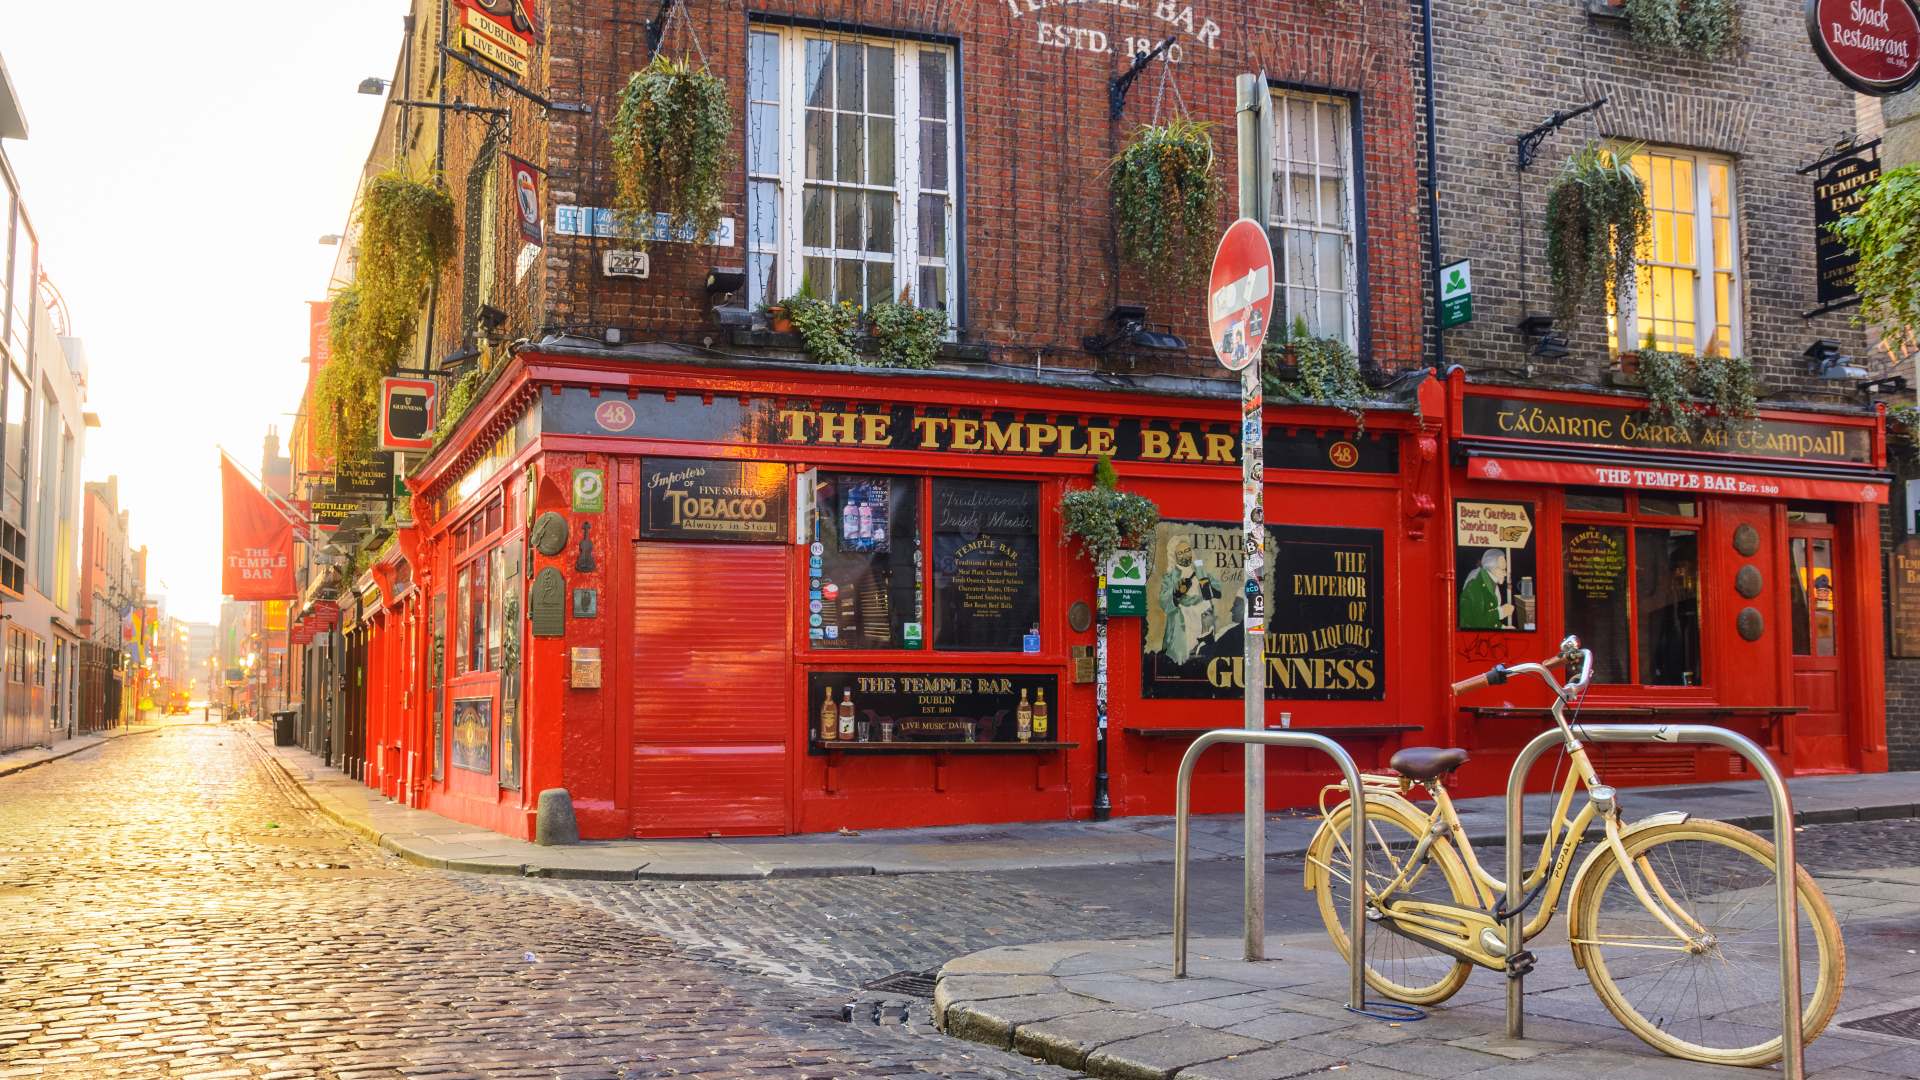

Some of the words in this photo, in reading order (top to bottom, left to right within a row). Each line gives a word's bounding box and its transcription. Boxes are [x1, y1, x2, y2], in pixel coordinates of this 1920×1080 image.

[1154, 0, 1221, 50] BAR
[1849, 0, 1890, 32] Shack
[480, 17, 516, 48] DUBLIN
[1832, 22, 1910, 59] Restaurant
[472, 35, 493, 56] LIVE
[495, 49, 524, 72] MUSIC
[1836, 164, 1858, 178] THE
[1817, 168, 1880, 201] TEMPLE
[602, 405, 626, 424] 48
[779, 409, 893, 447] THE
[914, 416, 1118, 456] TEMPLE
[1140, 429, 1236, 463] BAR
[1333, 445, 1352, 463] 48
[647, 466, 707, 489] Importers
[1596, 468, 1632, 484] THE
[1634, 471, 1700, 489] TEMPLE
[1703, 475, 1737, 491] BAR
[1761, 485, 1779, 495] 1840
[699, 486, 721, 495] FINE
[722, 486, 767, 497] SMOKING
[312, 502, 360, 511] DISTILLERY
[320, 511, 350, 519] STORE
[663, 489, 768, 526] TOBACCO
[1460, 506, 1481, 519] Beer
[1483, 507, 1517, 521] Garden
[684, 519, 724, 530] Always
[1460, 520, 1498, 534] Smoking
[1189, 534, 1273, 552] TEME
[1468, 532, 1490, 545] Area
[244, 548, 270, 558] THE
[955, 540, 997, 558] TEMPLE
[1000, 543, 1018, 560] BAR
[227, 556, 288, 568] TEMPLE
[1335, 551, 1367, 574] THE
[241, 568, 272, 580] BAR
[1293, 574, 1367, 598] EMPEROR
[1348, 602, 1367, 622] OF
[1264, 632, 1310, 655] ALTED
[1311, 623, 1375, 653] LIQUORS
[1206, 656, 1376, 690] GUNNESS
[857, 677, 897, 694] THE
[900, 678, 973, 695] TEMPLE
[977, 678, 1014, 695] BAR
[918, 695, 955, 705] DUBLIN
[901, 721, 921, 731] LIVE
[922, 721, 946, 731] MUSIC
[1554, 841, 1572, 879] POPAL
